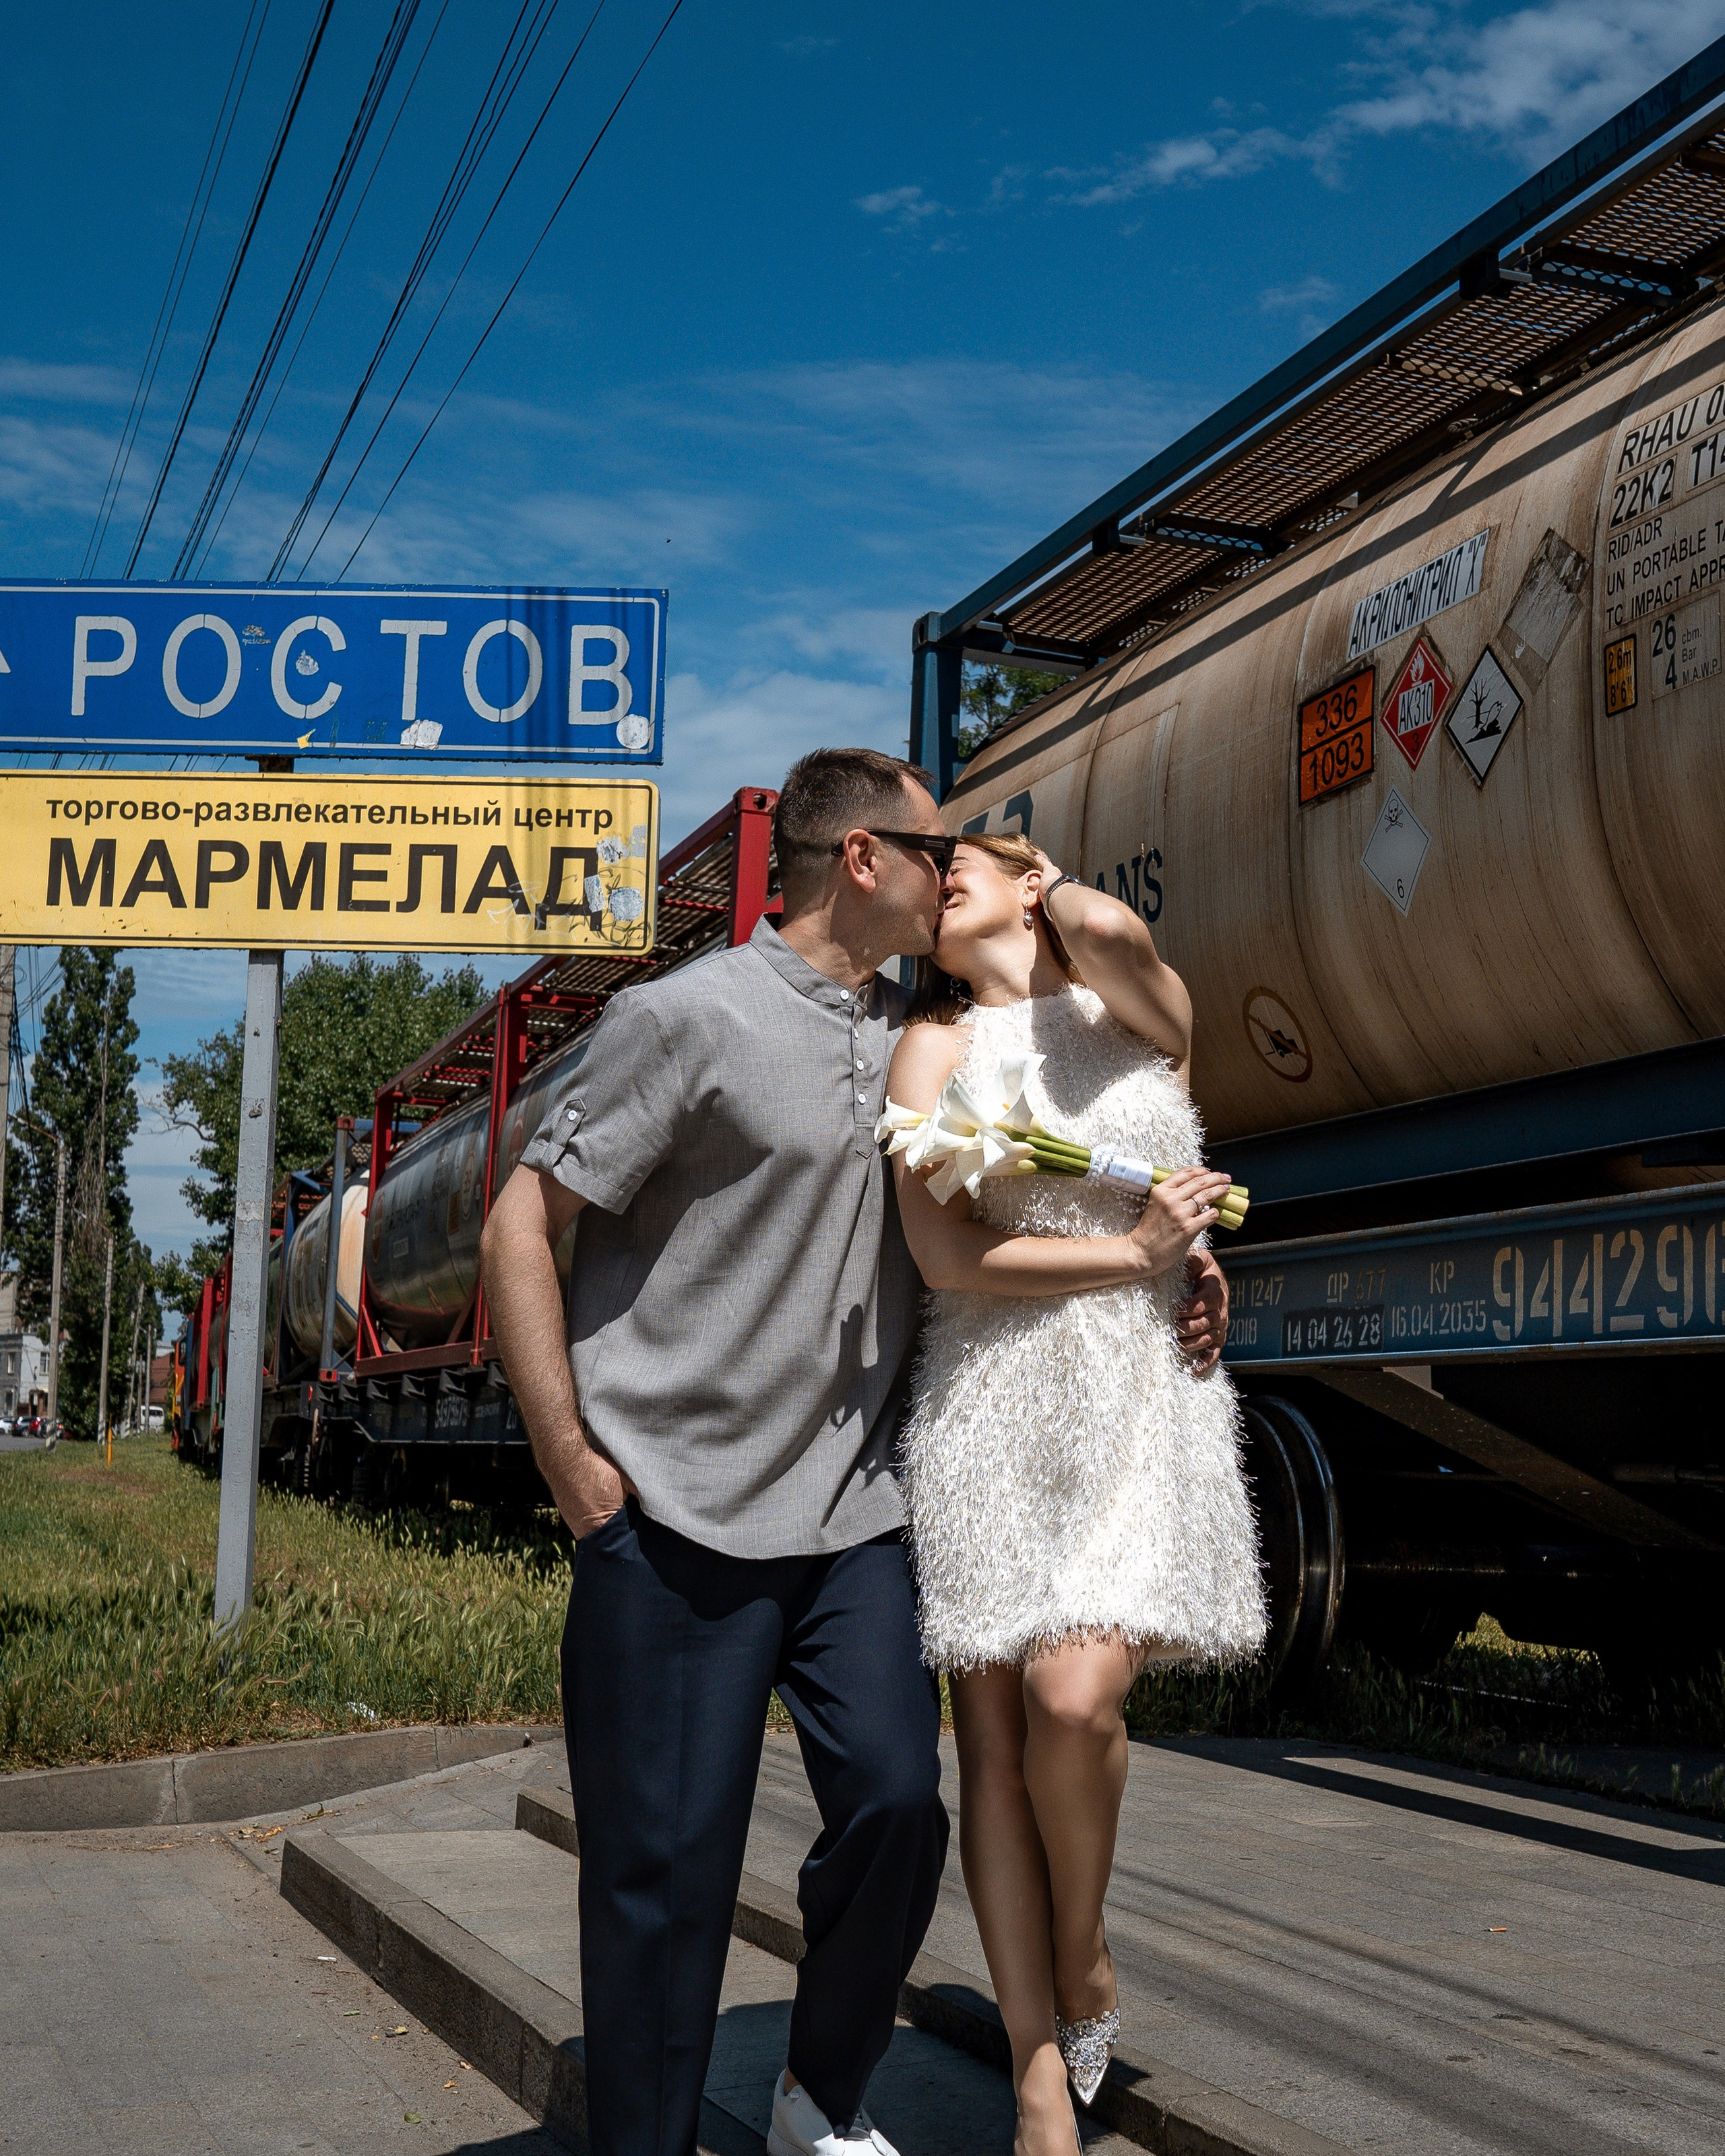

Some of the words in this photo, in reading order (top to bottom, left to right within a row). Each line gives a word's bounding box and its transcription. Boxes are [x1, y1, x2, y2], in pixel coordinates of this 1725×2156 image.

[1617, 397, 1700, 474] RHAU
[1706, 384, 1725, 426] 0
[1610, 459, 1675, 528] 22K2
[1607, 568, 1625, 596] UN
[1633, 528, 1707, 585] PORTABLE
[1715, 519, 1725, 544] T
[1608, 516, 1663, 563] RID/ADR
[1348, 546, 1464, 658] АКРИЛОНИТРИЛ
[1606, 604, 1623, 630] TC
[1631, 575, 1682, 620] IMPACT
[1652, 613, 1676, 658] 26
[1681, 627, 1702, 645] cbm.
[71, 614, 633, 725] РОСТОВ
[1665, 652, 1678, 689] 4
[1682, 647, 1697, 663] Bar
[1683, 658, 1721, 685] M.A.W.P.
[1315, 684, 1358, 738] 336
[1399, 682, 1433, 734] АК310
[1309, 732, 1365, 791] 1093
[1412, 732, 1420, 753] 3
[46, 799, 501, 827] торгово-развлекательный
[514, 807, 613, 835] центр
[46, 837, 602, 931] МАРМЕЛАД
[1397, 877, 1405, 899] 6
[1251, 1275, 1284, 1307] 1247
[1430, 1261, 1455, 1294] КР
[1288, 1320, 1302, 1352] 14
[1307, 1316, 1327, 1350] 04
[1358, 1313, 1381, 1346] 28
[1391, 1300, 1486, 1337] 16.04.2035
